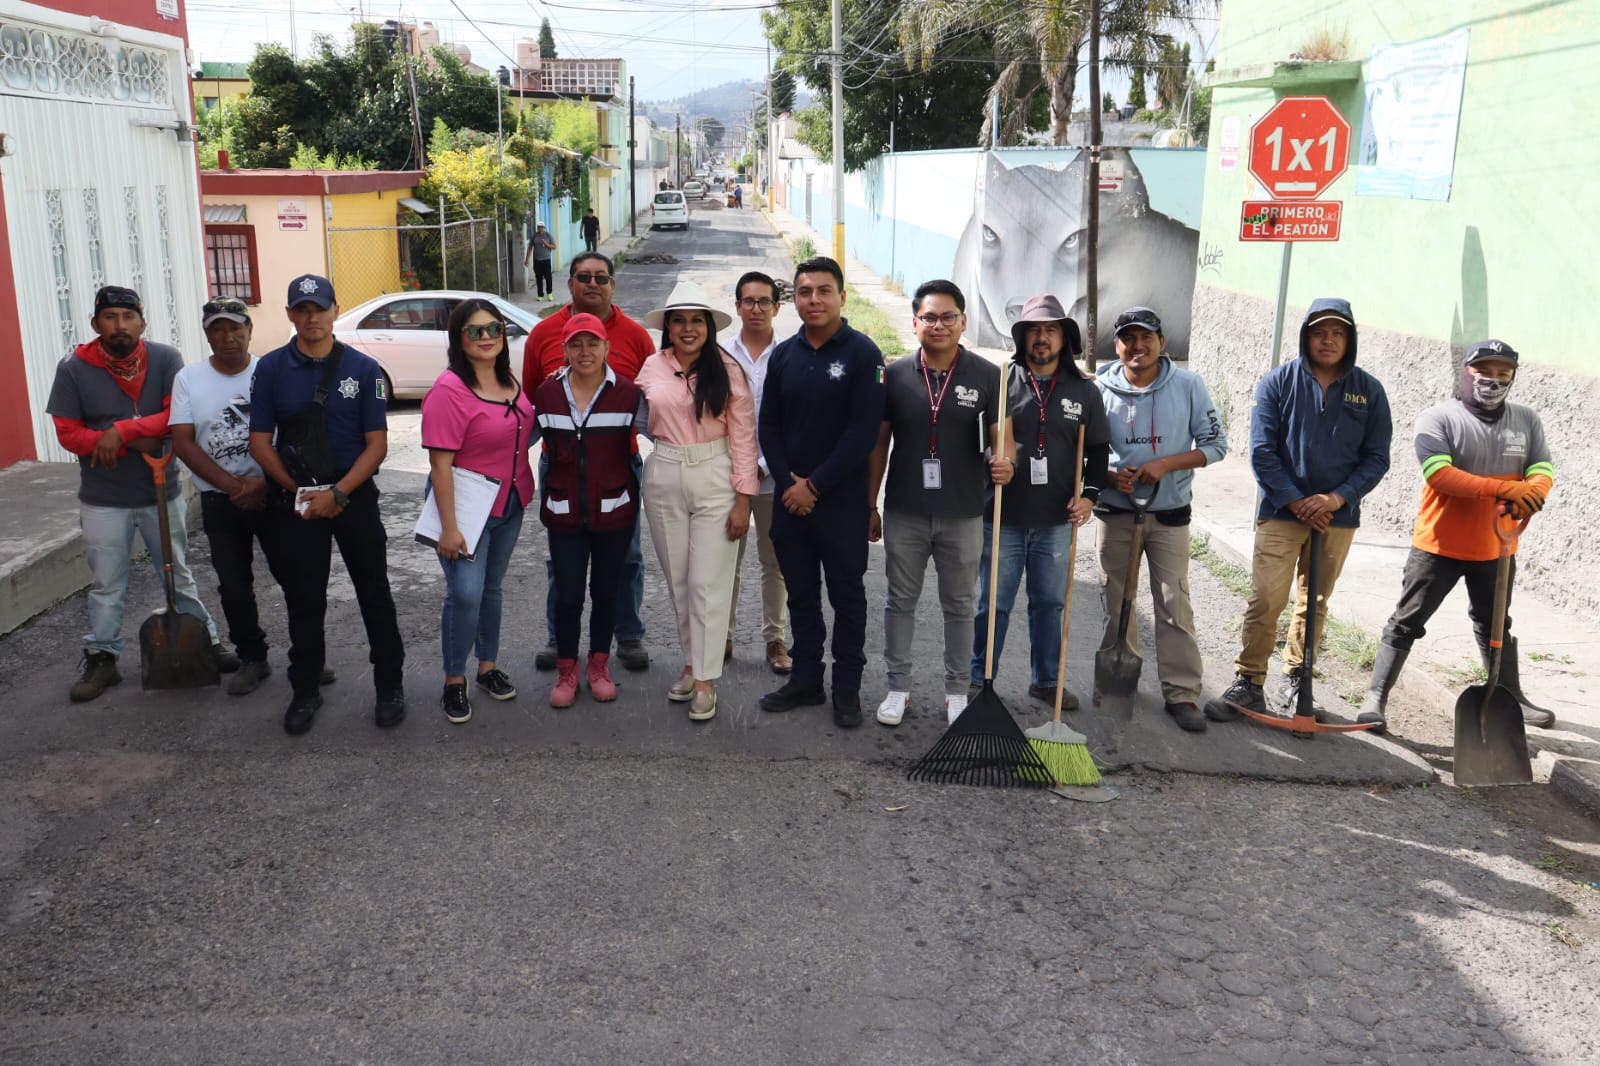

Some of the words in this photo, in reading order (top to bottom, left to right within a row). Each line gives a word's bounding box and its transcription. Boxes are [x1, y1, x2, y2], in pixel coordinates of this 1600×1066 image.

[1265, 127, 1337, 171] 1x1
[1261, 207, 1324, 219] PRIMERO
[1252, 223, 1270, 235] EL
[1274, 220, 1328, 235] PEATÓN
[1125, 436, 1162, 445] LACOSTE
